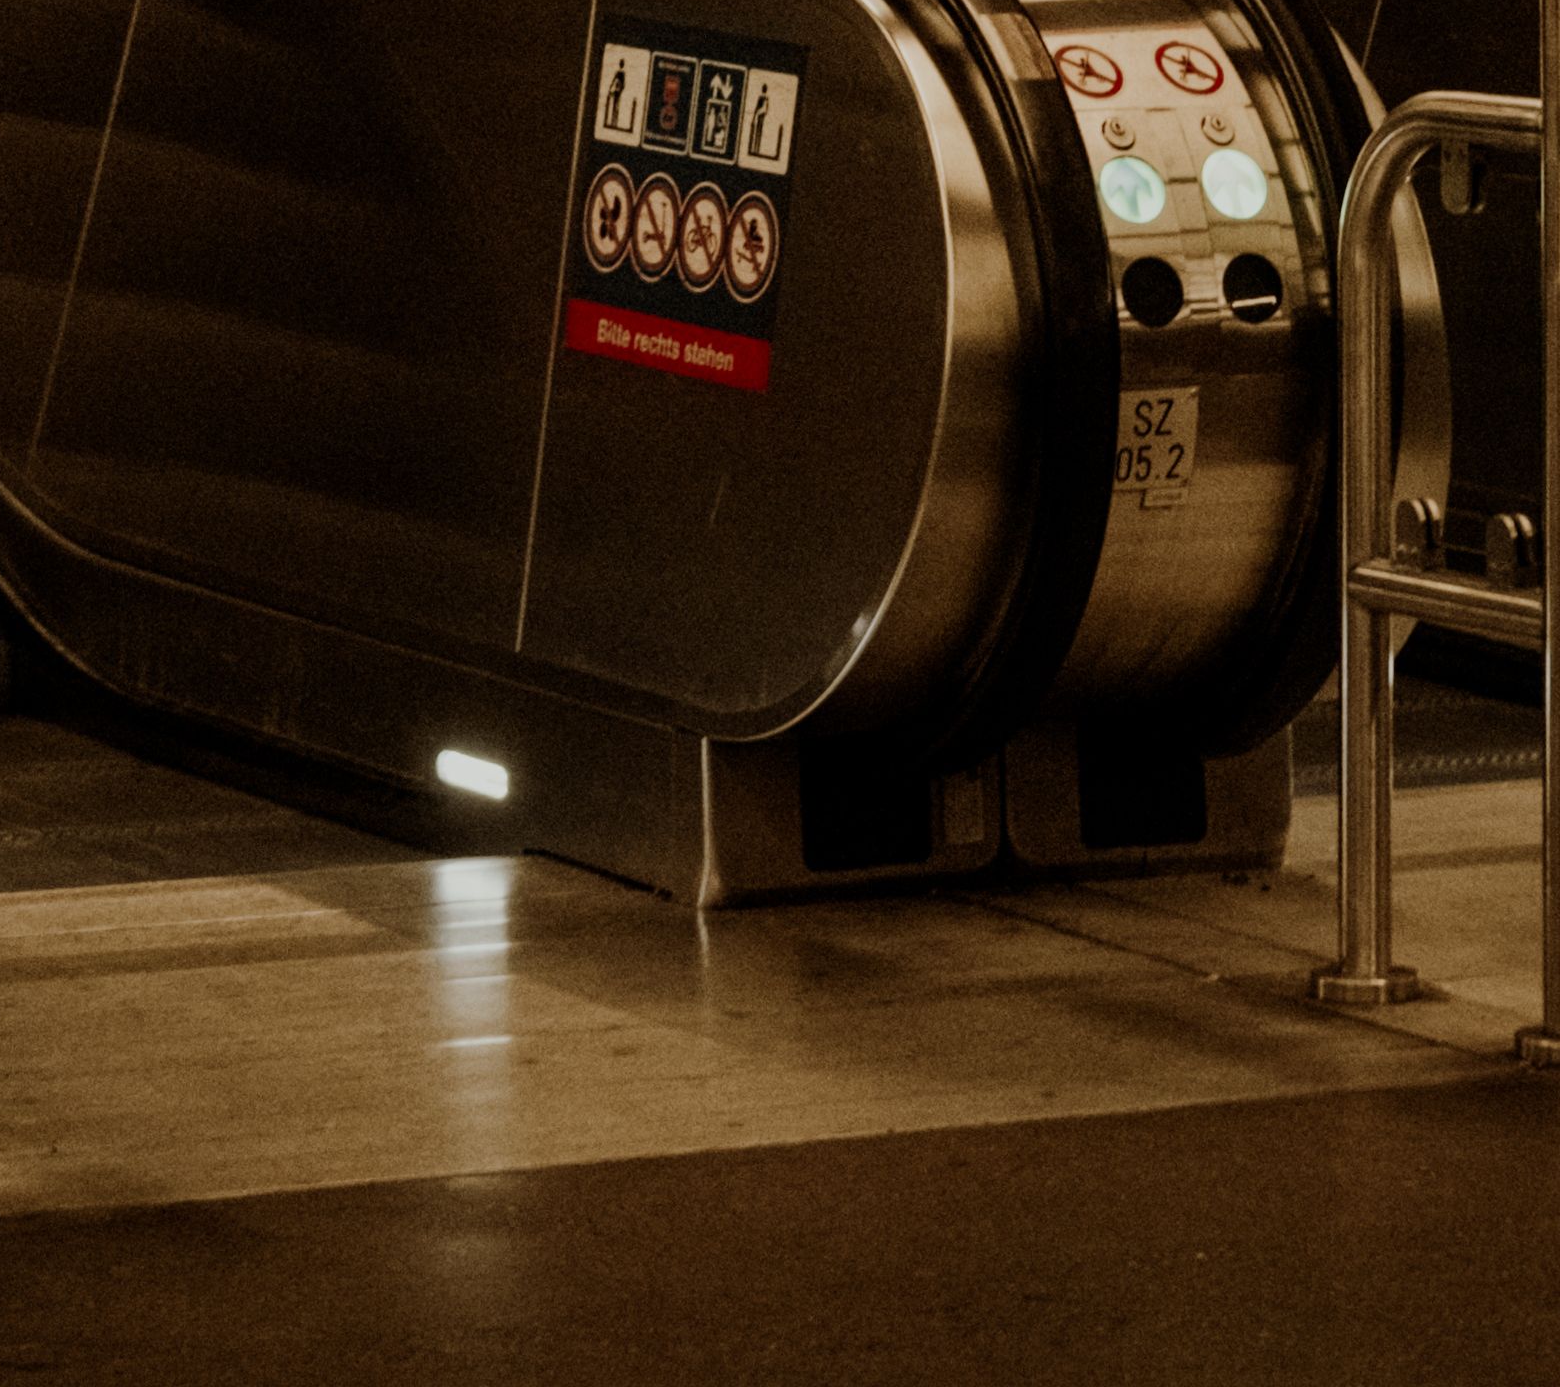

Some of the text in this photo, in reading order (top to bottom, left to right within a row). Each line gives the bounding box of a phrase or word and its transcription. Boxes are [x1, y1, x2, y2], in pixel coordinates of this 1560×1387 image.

[596, 317, 734, 372] Bitte rechts stehen
[1133, 398, 1174, 437] SZ
[1116, 443, 1185, 483] 05.2
